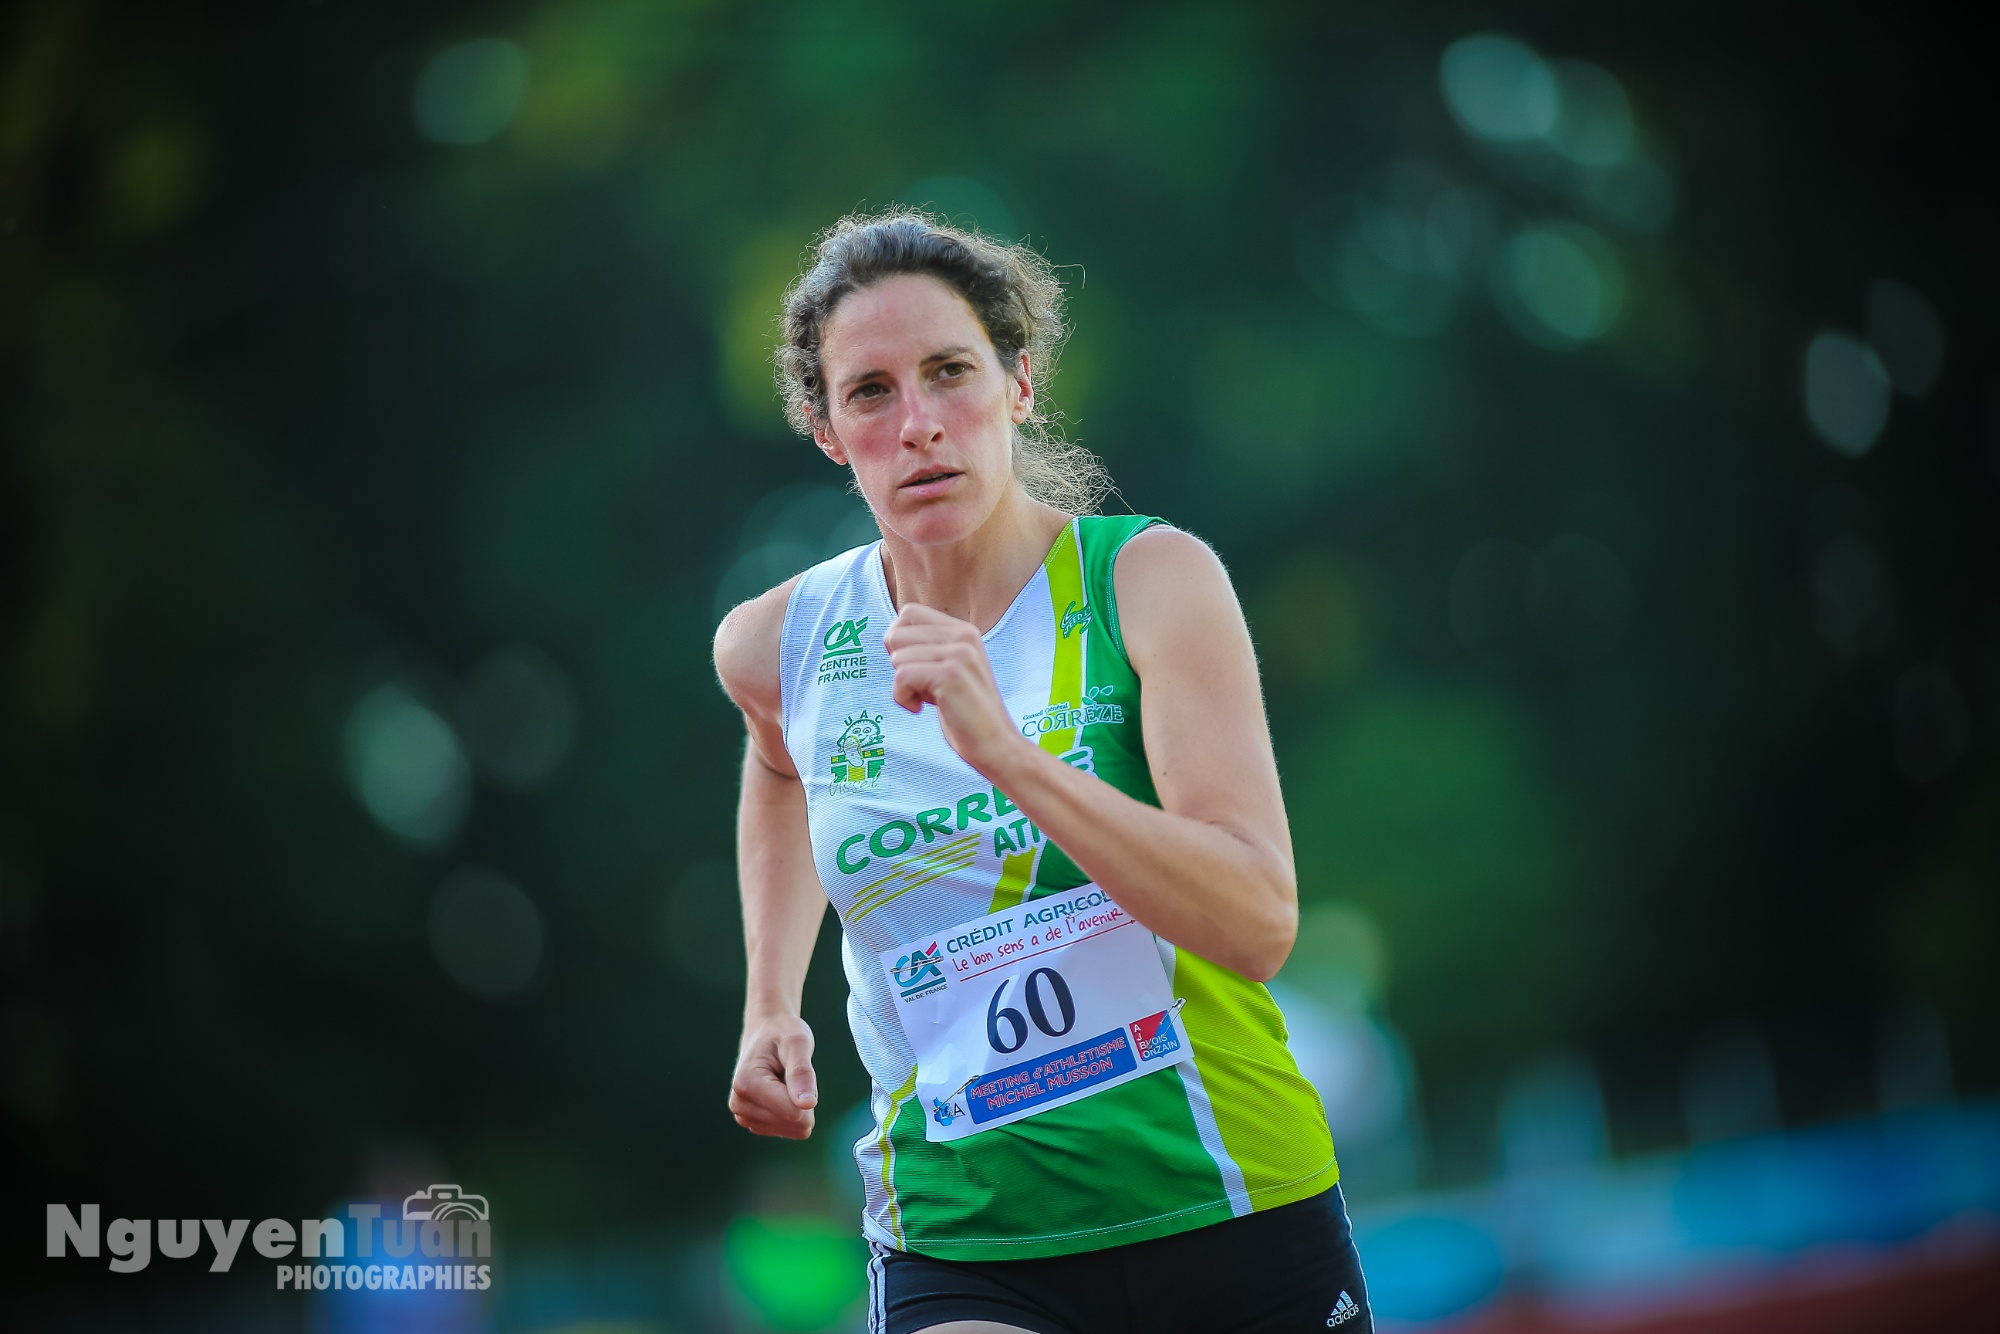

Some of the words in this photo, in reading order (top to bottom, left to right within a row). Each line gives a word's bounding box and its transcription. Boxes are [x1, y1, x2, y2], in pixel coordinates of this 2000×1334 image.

[819, 656, 868, 673] CENTRE
[817, 668, 868, 686] FRANCE
[844, 709, 884, 726] UAC
[946, 918, 1014, 954] CRÉDIT
[1023, 889, 1113, 929] AGRICOL
[952, 958, 970, 972] Le
[969, 951, 994, 966] bon
[997, 938, 1025, 958] sens
[1031, 935, 1040, 946] a
[1045, 926, 1062, 942] de
[904, 995, 916, 1004] VAL
[925, 984, 948, 996] FRANCE
[986, 966, 1076, 1055] 60
[1142, 1040, 1178, 1058] ONZAIN
[970, 1071, 1030, 1100] MEETING
[1032, 1036, 1127, 1079] d'ATHLETISME
[986, 1082, 1046, 1110] MICHEL
[1046, 1057, 1114, 1091] MUSSON
[1326, 1304, 1360, 1328] adidas
